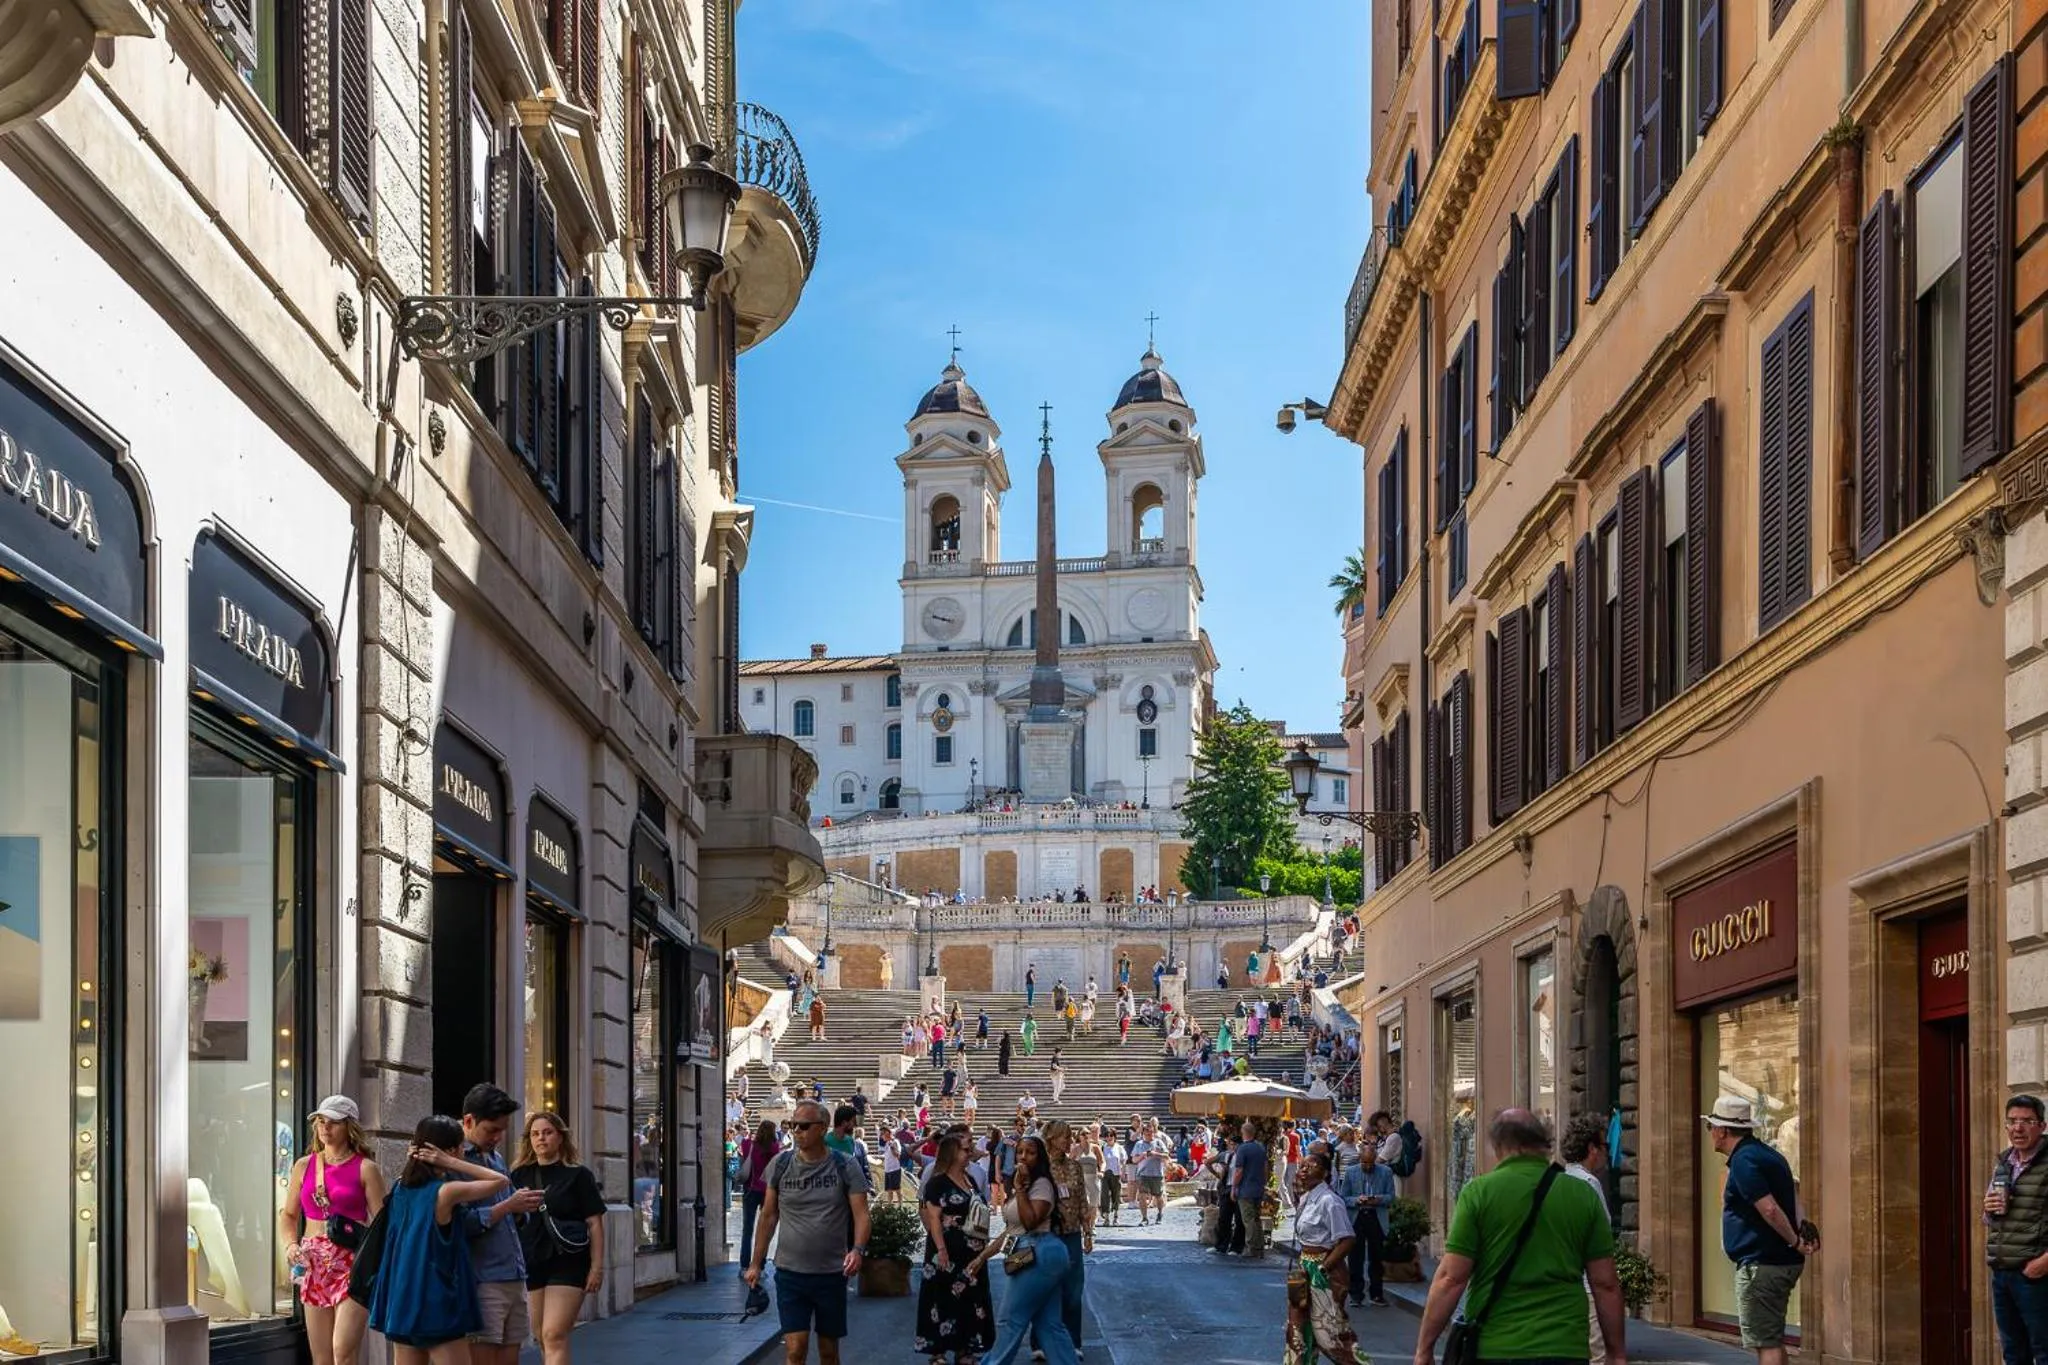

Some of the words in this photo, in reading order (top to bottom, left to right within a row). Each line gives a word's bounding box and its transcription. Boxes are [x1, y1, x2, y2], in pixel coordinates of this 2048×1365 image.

[218, 596, 305, 689] PRADA
[439, 764, 492, 821] PRADA
[534, 829, 568, 875] PRADA
[1690, 899, 1769, 961] GUCCI
